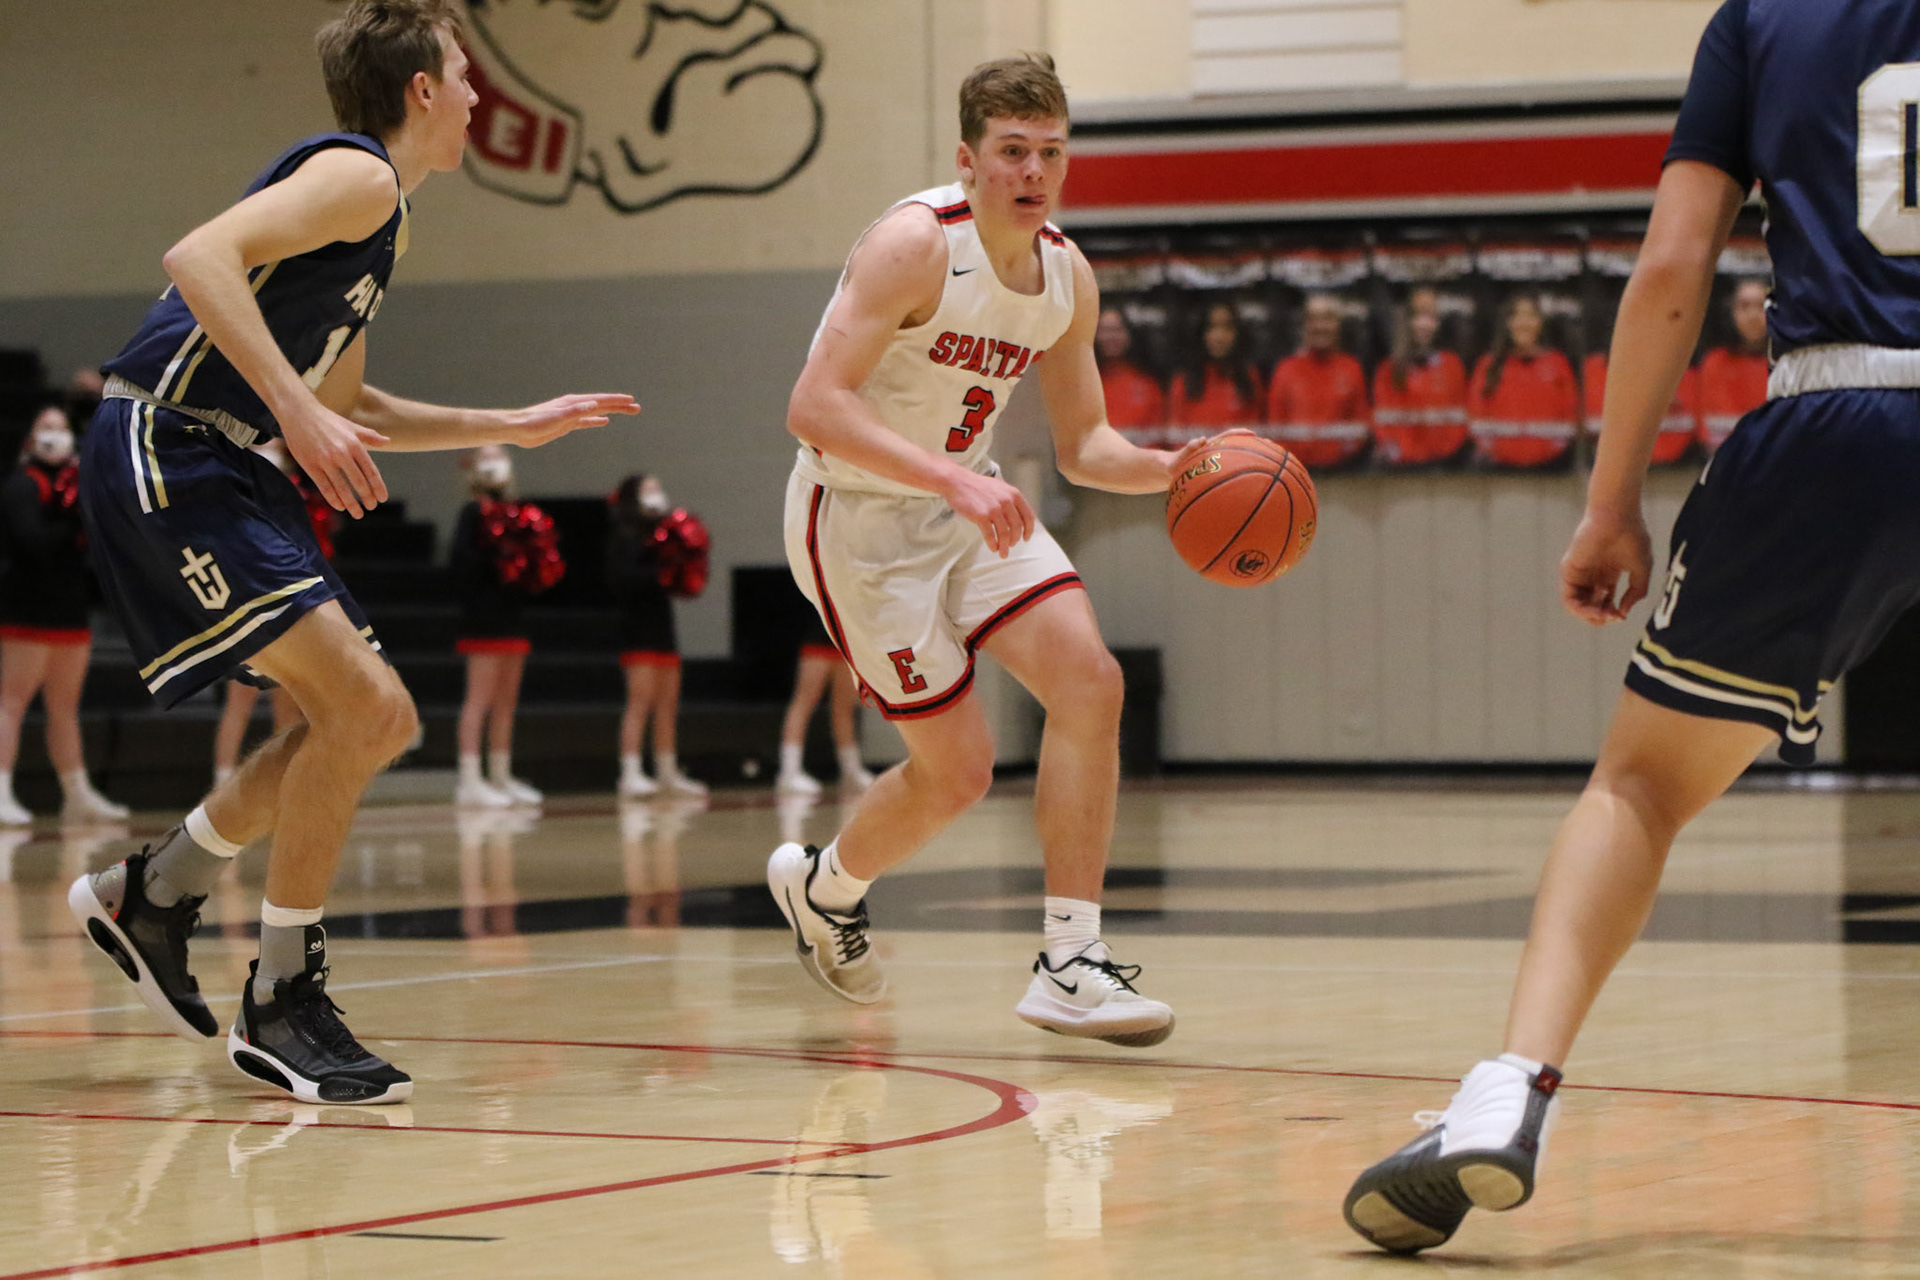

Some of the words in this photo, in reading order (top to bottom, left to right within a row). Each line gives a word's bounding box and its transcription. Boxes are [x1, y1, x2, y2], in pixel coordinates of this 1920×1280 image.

[928, 330, 1044, 381] SPATA
[944, 385, 996, 453] 3
[887, 646, 929, 695] E
